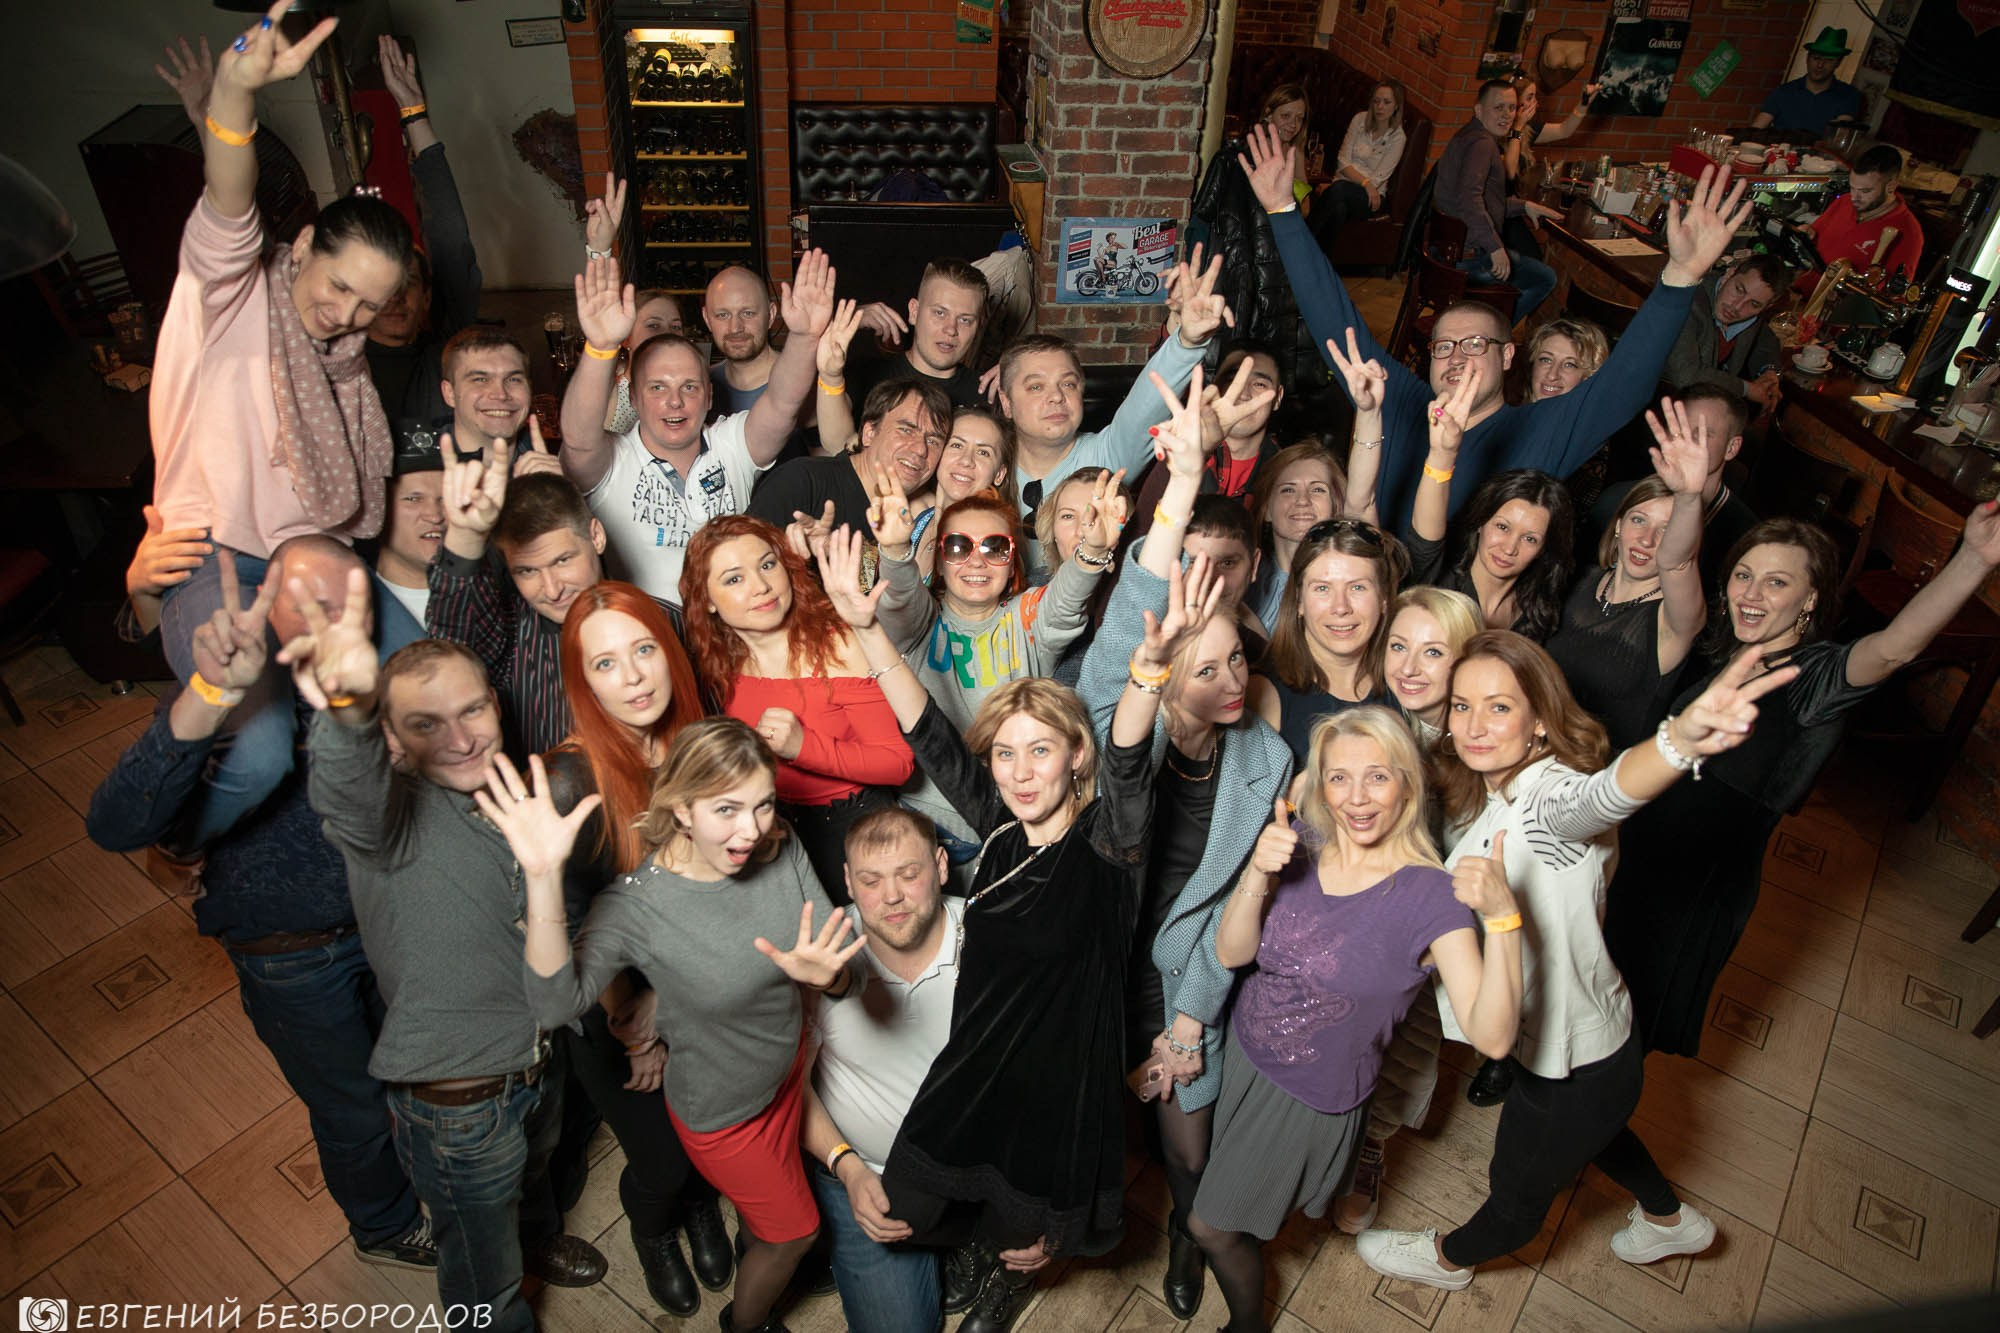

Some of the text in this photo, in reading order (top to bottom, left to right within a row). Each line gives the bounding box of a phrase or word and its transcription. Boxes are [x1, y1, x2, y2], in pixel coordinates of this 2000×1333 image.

[1648, 38, 1683, 49] GUINNESS
[1133, 222, 1161, 241] Best
[1139, 232, 1169, 247] GARAGE
